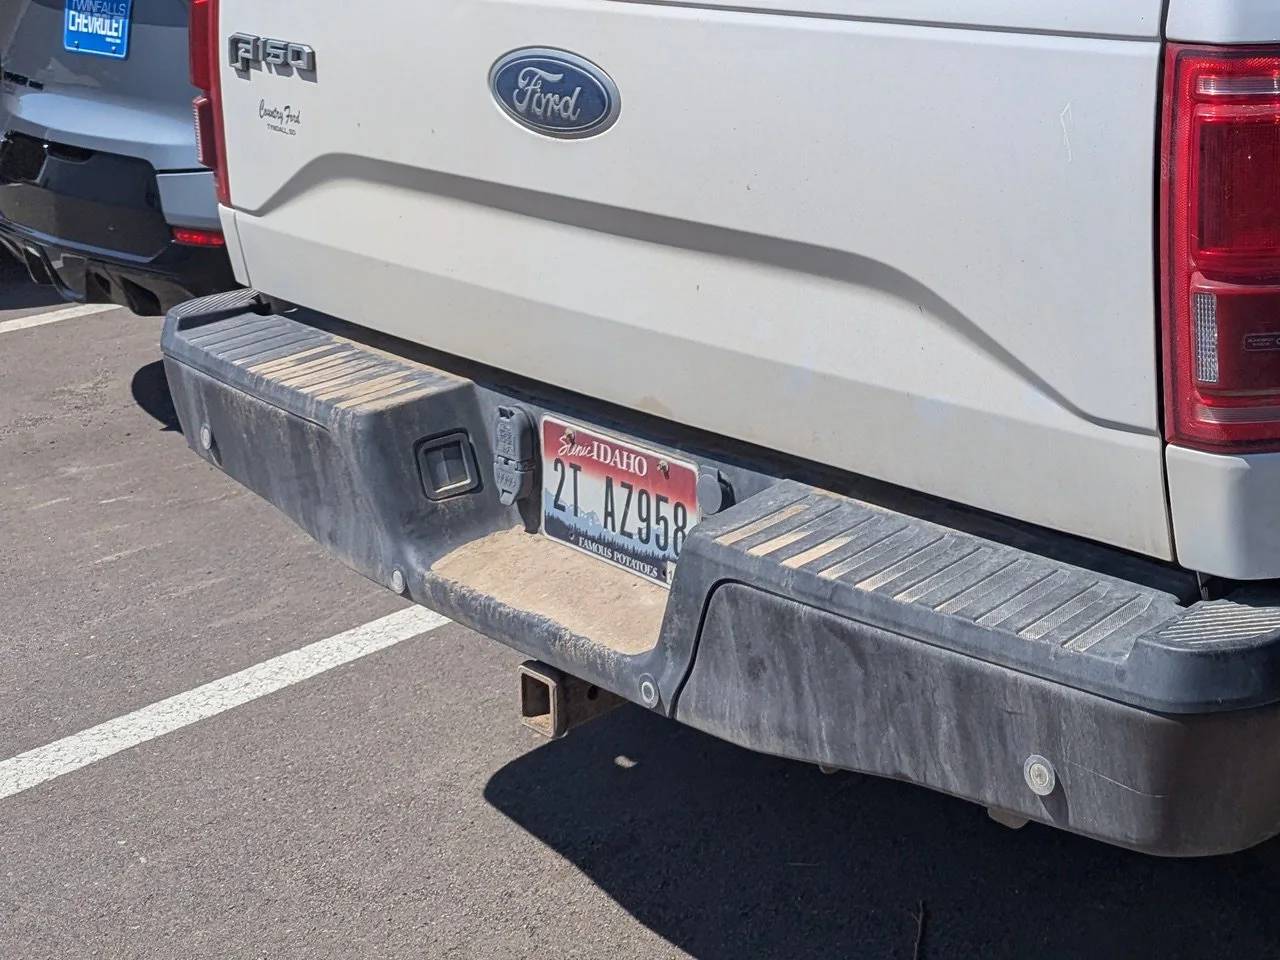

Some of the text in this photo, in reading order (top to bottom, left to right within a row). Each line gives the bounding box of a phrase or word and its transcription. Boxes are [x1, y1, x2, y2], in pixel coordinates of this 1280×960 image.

[68, 10, 124, 37] CHEVROLET
[512, 66, 582, 121] Ford
[283, 105, 301, 125] Ford
[591, 441, 648, 477] IDAHO
[553, 457, 688, 559] 2T AZ958
[578, 536, 658, 577] FAMOUS POTATOES
